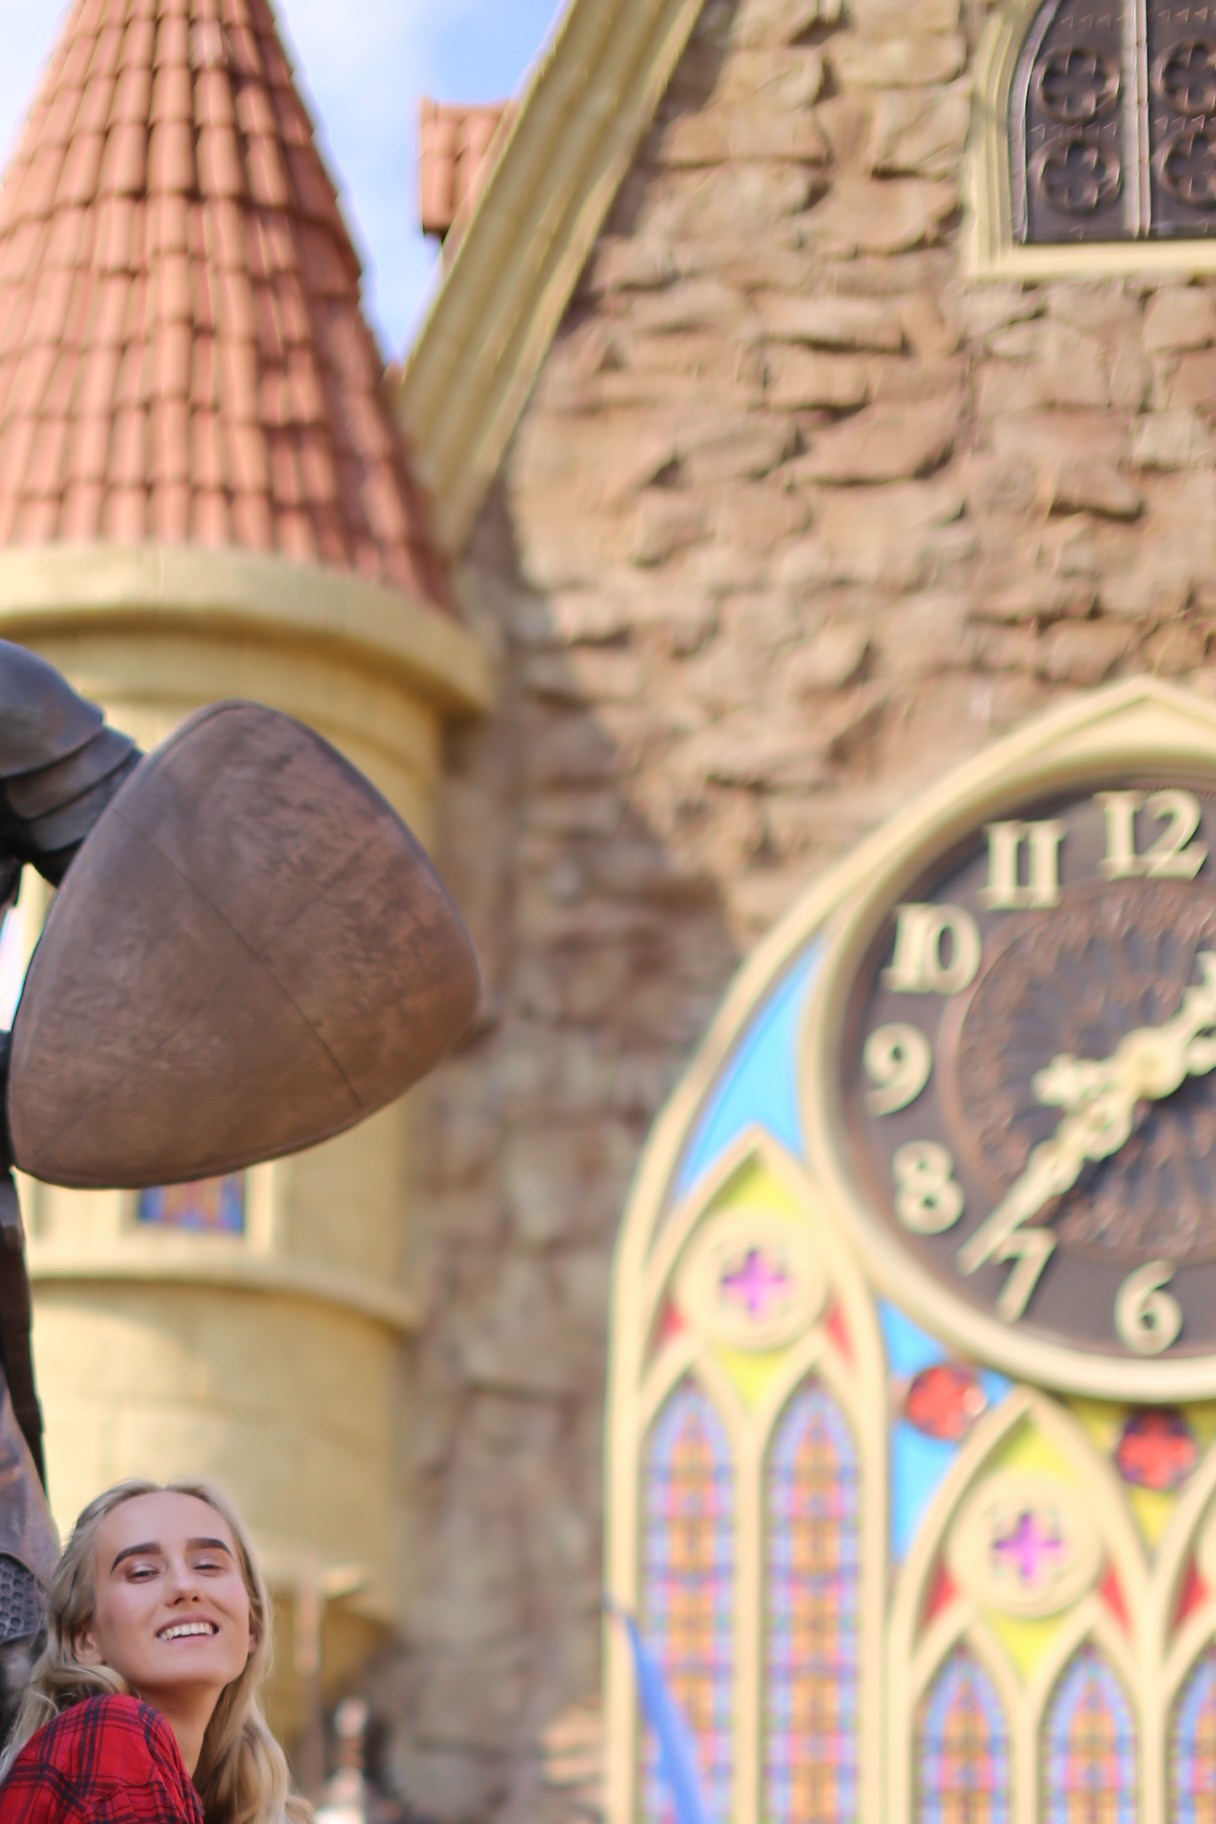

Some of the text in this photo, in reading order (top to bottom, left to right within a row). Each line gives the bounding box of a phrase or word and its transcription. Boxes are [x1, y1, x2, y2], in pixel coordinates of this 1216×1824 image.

[1092, 790, 1210, 882] 12
[882, 902, 982, 995] 10
[863, 1022, 931, 1117] 9
[891, 1139, 964, 1235] 8
[991, 1227, 1058, 1324] 7
[1114, 1259, 1184, 1355] 6
